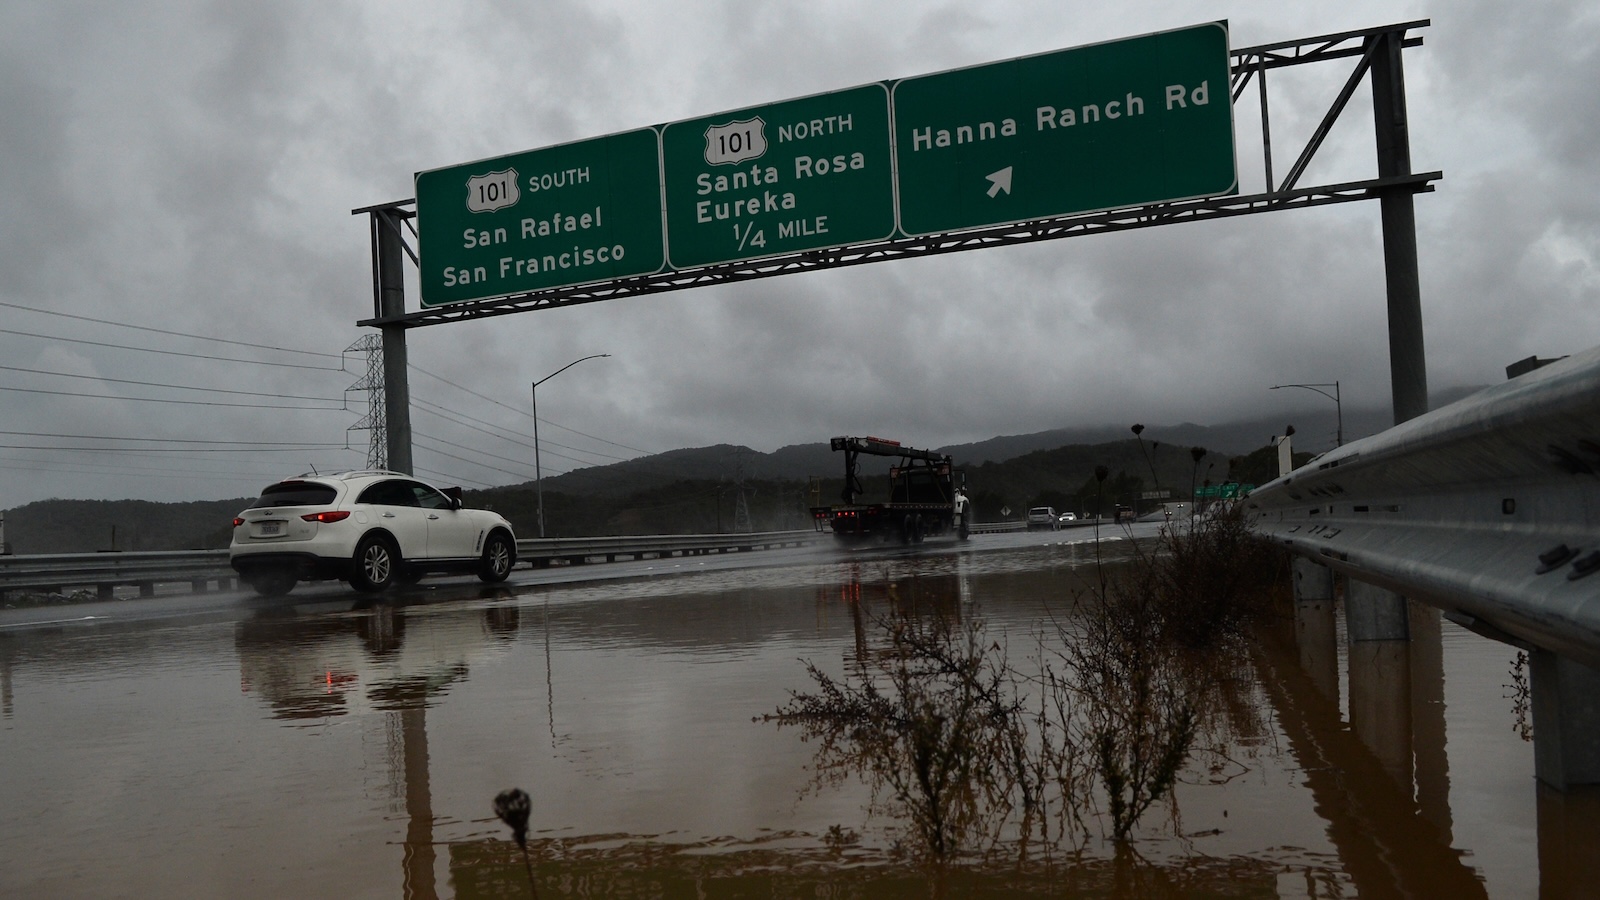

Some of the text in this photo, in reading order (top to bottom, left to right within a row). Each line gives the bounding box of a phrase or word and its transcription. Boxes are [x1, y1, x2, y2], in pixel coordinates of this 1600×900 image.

[720, 114, 853, 155] 101 NORTH
[913, 80, 1209, 151] Hanna Ranch Rd
[479, 167, 590, 204] 101 SOUTH
[697, 152, 865, 195] Santa Rosa
[463, 206, 602, 248] San Rafael
[697, 191, 796, 223] Eureka
[733, 216, 829, 251] 1/4 MILE
[443, 244, 625, 287] San Francisco
